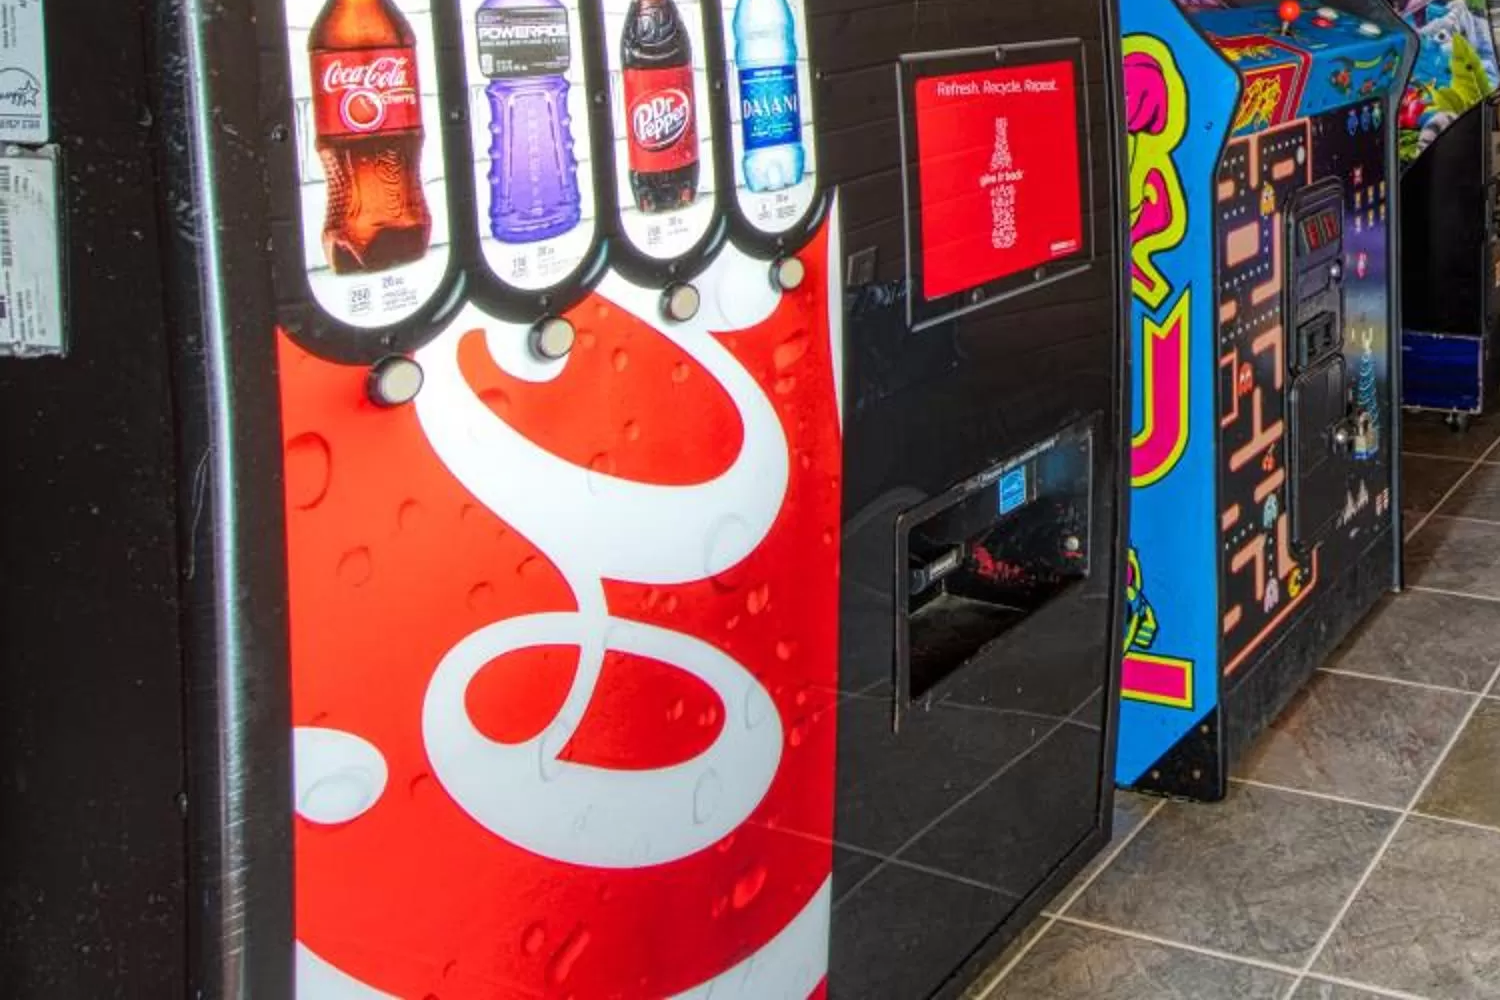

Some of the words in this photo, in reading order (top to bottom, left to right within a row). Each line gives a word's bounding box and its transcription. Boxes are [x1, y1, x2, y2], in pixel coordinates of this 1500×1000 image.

[323, 57, 409, 94] Coca-Cola
[936, 81, 980, 97] Refresh.
[742, 94, 798, 120] DASANI
